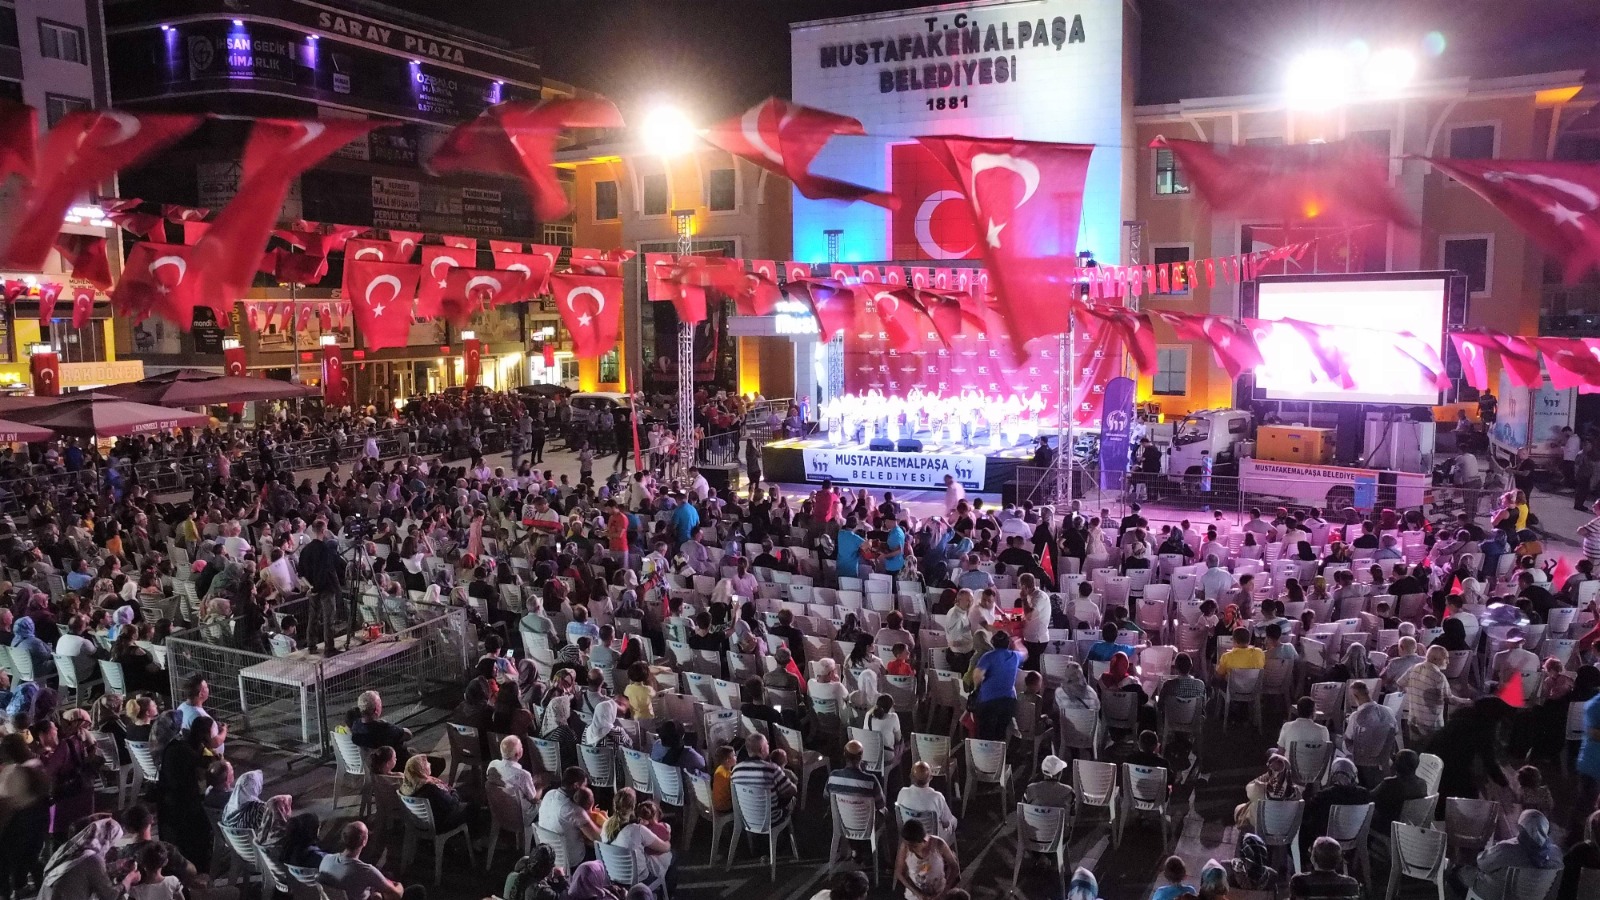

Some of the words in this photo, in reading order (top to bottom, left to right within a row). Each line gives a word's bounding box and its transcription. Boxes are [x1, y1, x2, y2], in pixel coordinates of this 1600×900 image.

[924, 13, 978, 32] T.C.
[319, 12, 392, 44] SARAY
[404, 34, 465, 64] PLAZA
[820, 14, 1086, 69] MUSTAFAKEMALPAŞA
[925, 94, 968, 111] 1881
[62, 368, 92, 382] RAK
[96, 364, 141, 380] DÖNER
[835, 454, 949, 472] MUSTAFAKEMALPAŞA
[1254, 464, 1322, 478] MUSTAFAKEMALPAŞA
[1322, 470, 1355, 480] BELEDİYE
